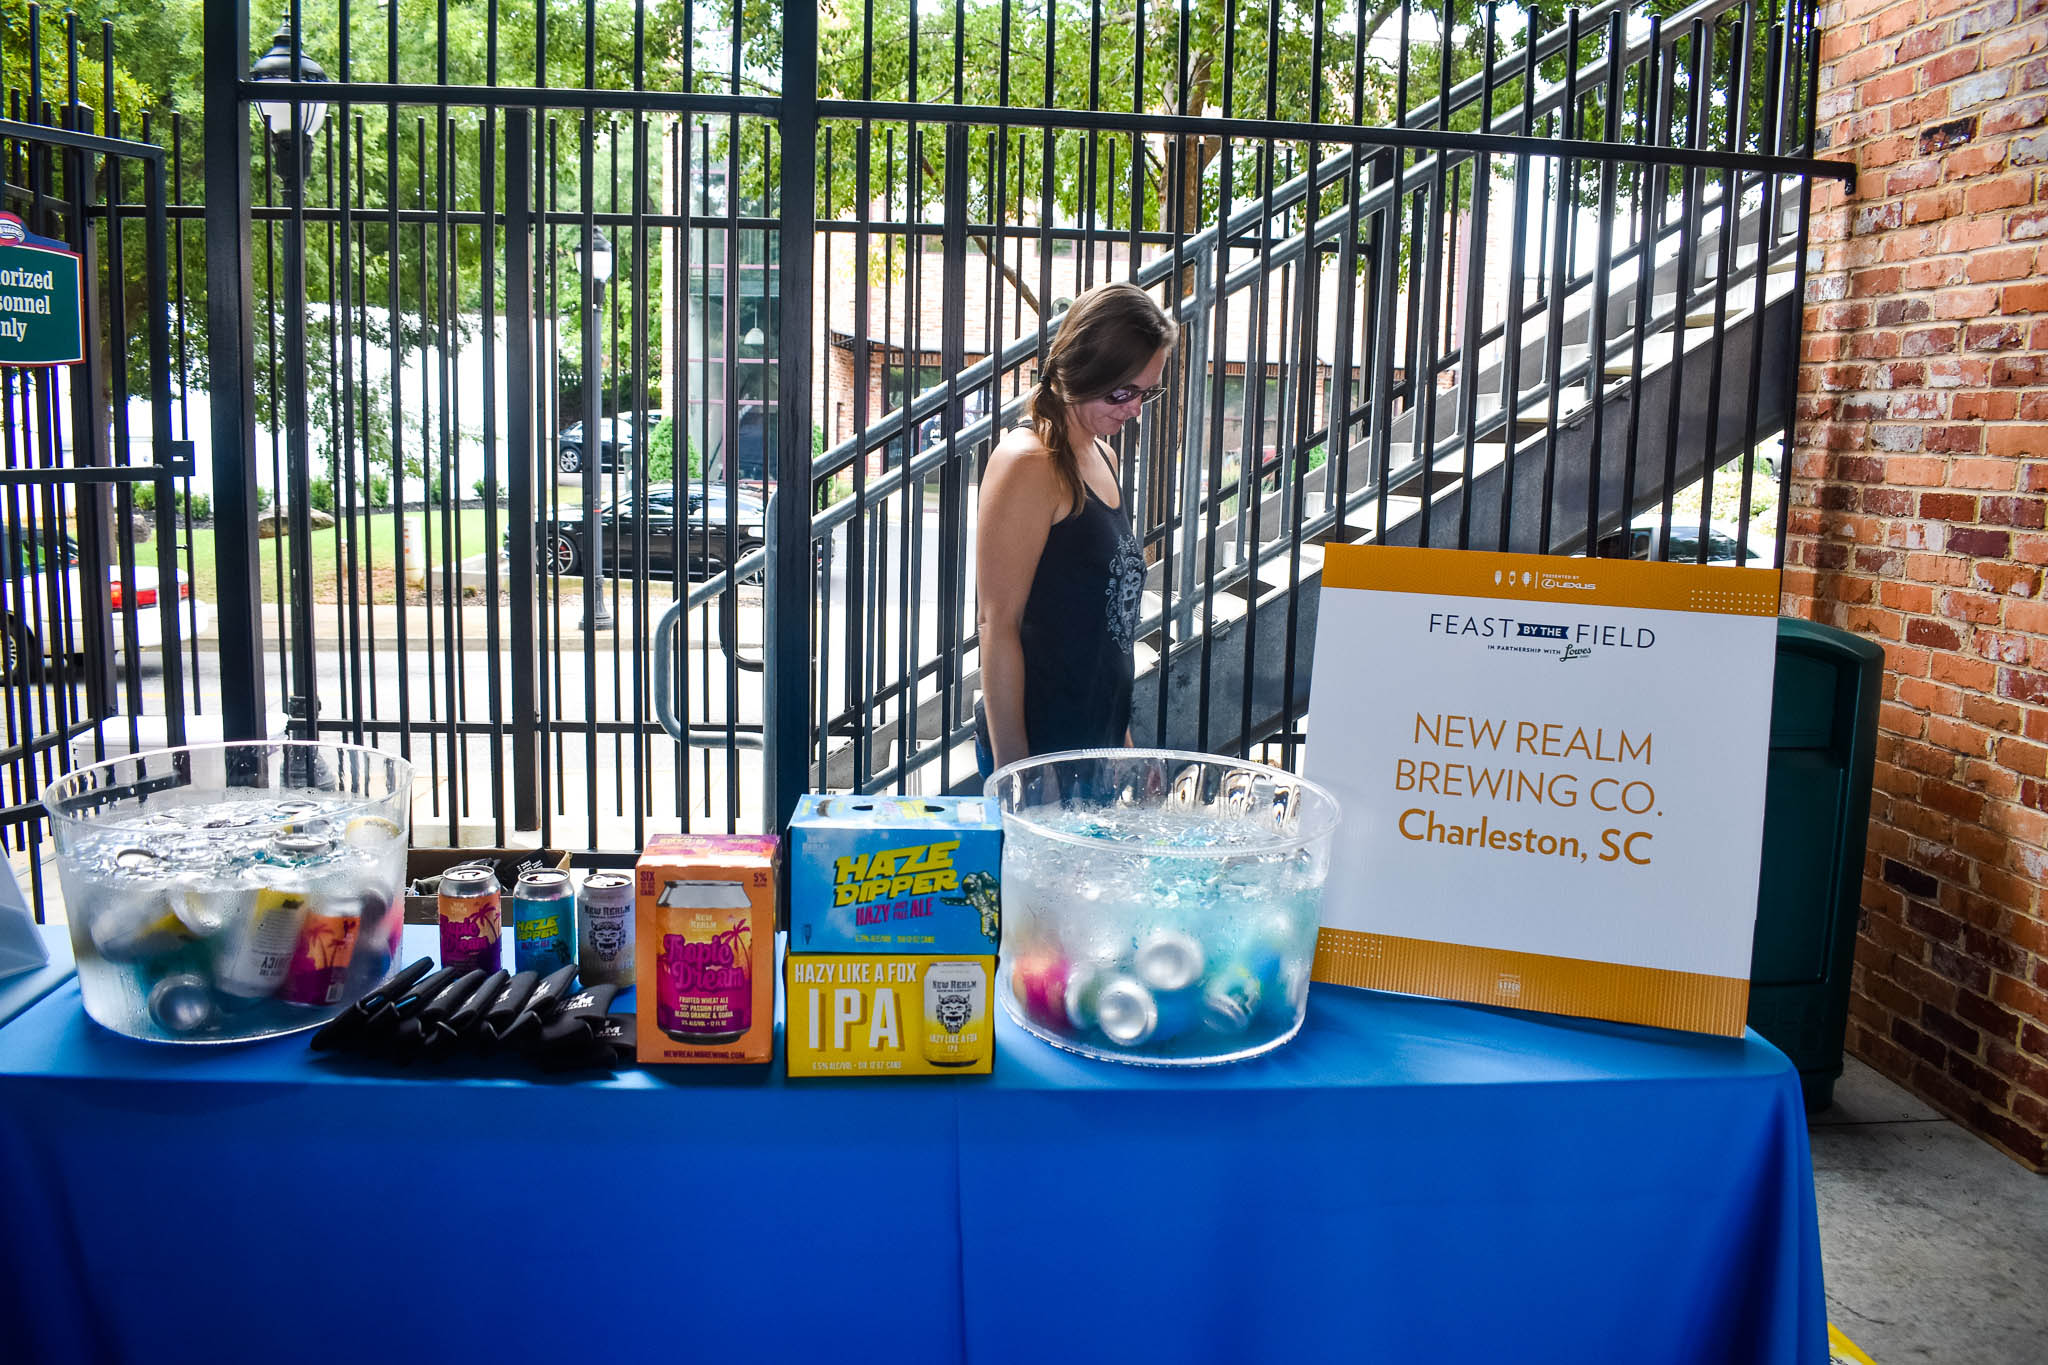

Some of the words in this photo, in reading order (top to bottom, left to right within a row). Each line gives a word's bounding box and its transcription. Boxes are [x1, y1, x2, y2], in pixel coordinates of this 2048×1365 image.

[0, 267, 53, 290] orized
[0, 317, 28, 343] nly
[1556, 581, 1596, 590] LEXUS
[1429, 613, 1514, 638] FEAST
[1523, 625, 1537, 635] BY
[1540, 627, 1562, 637] THE
[1576, 624, 1656, 649] FIELD
[1497, 645, 1541, 653] PARTNERSHIP
[1414, 711, 1507, 751] NEW
[1516, 721, 1652, 766] REALM
[1395, 759, 1578, 808] BREWING
[1590, 778, 1663, 817] CO.
[1398, 808, 1588, 864] Charleston,
[1598, 828, 1654, 866] SC
[640, 871, 655, 882] SIX
[753, 872, 767, 882] 5%
[834, 840, 960, 885] HAZE
[834, 869, 959, 908] DIPPER
[603, 905, 631, 915] REALM
[856, 904, 891, 927] HAZY
[911, 897, 934, 918] ALE
[664, 934, 732, 968] Tropic
[672, 961, 744, 991] Dream
[795, 964, 835, 983] HAZY
[838, 964, 870, 983] LIKE
[874, 964, 884, 982] A
[887, 964, 916, 982] FOX
[951, 980, 977, 989] REALM
[808, 988, 899, 1049] IPA
